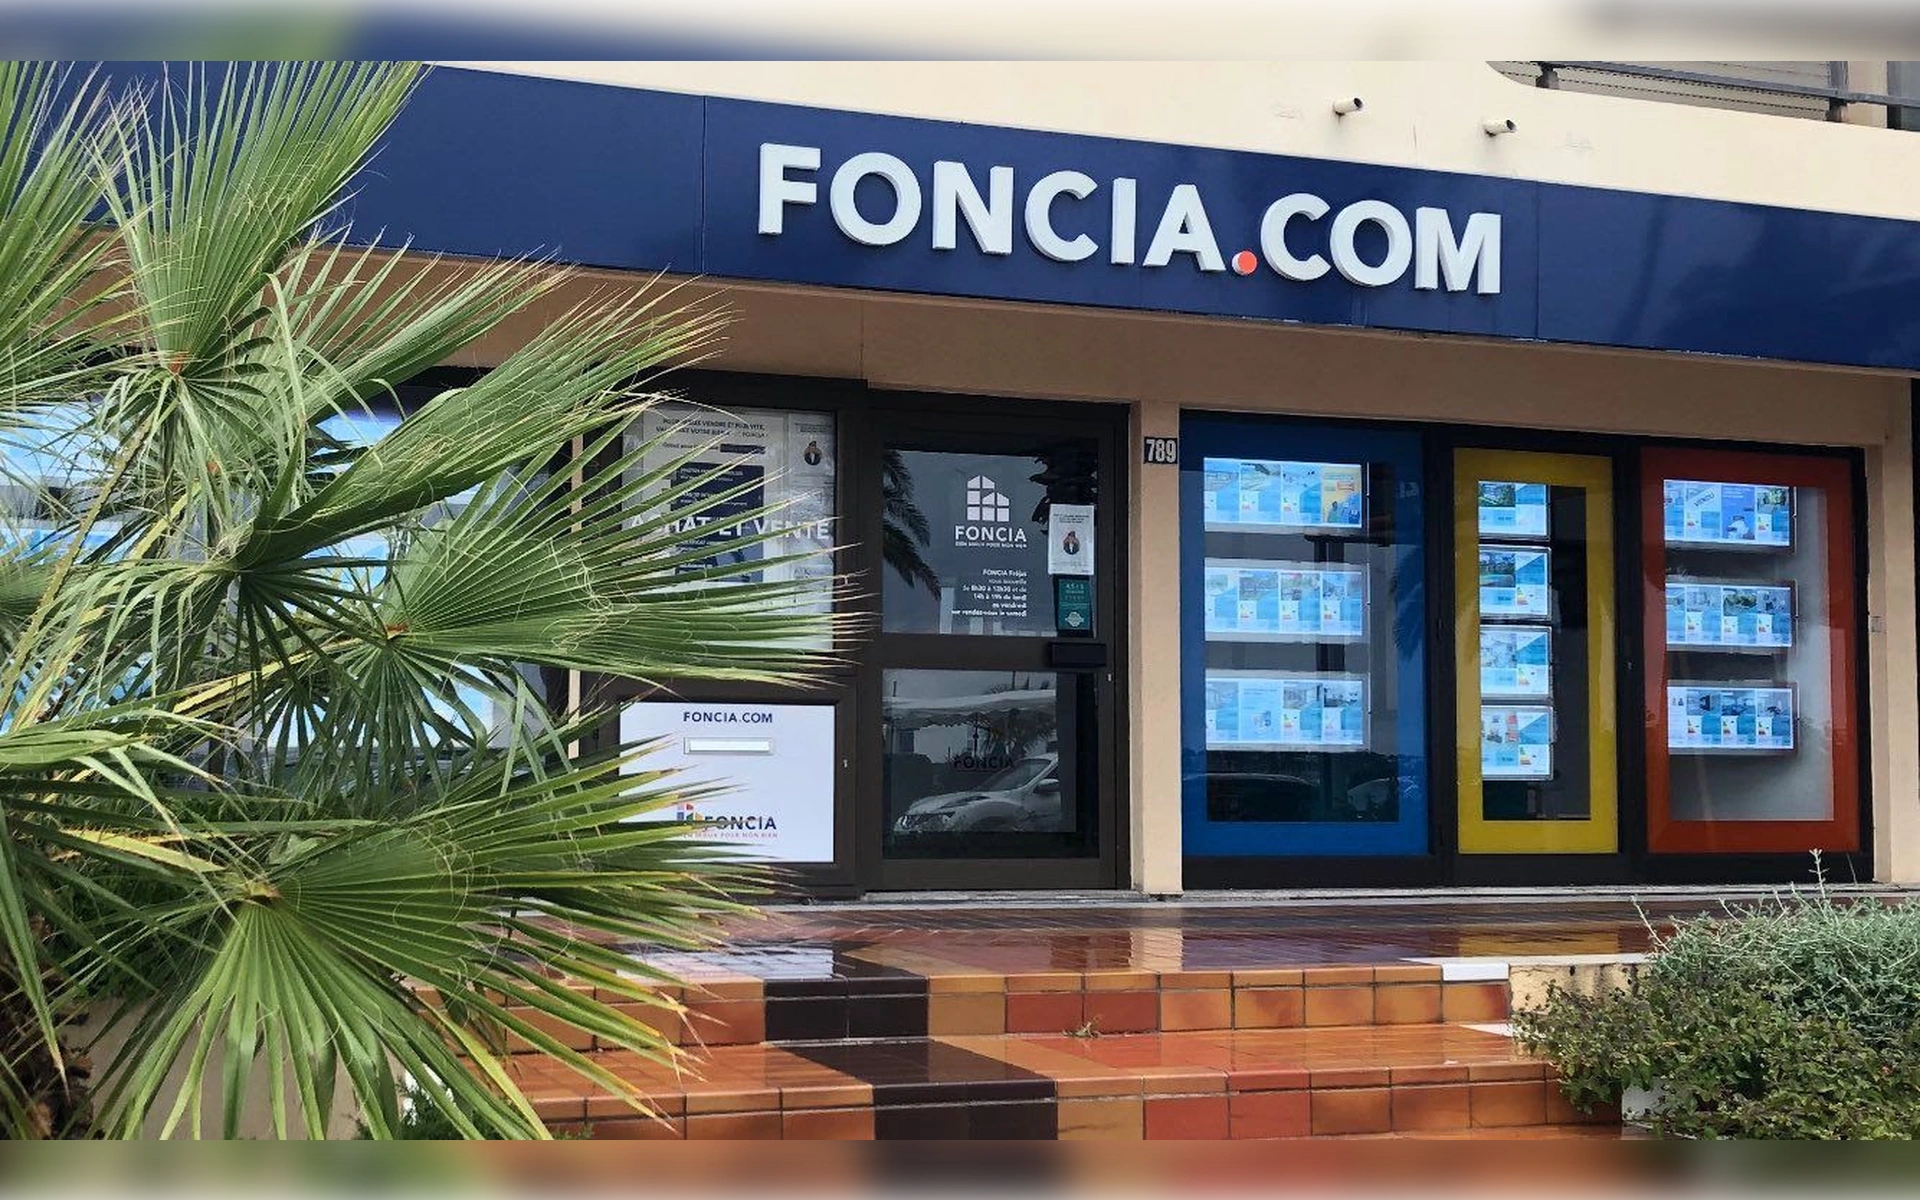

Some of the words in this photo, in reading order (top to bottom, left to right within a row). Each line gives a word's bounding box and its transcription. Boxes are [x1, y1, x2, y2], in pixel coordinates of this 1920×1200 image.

[758, 143, 1502, 295] FONCIA.COM
[1146, 439, 1176, 463] 789
[631, 515, 713, 535] AHAT
[754, 519, 832, 540] VENTE
[955, 525, 1027, 542] FONCIA
[683, 711, 773, 724] FONCIA.COM
[953, 755, 1014, 769] FONCIA
